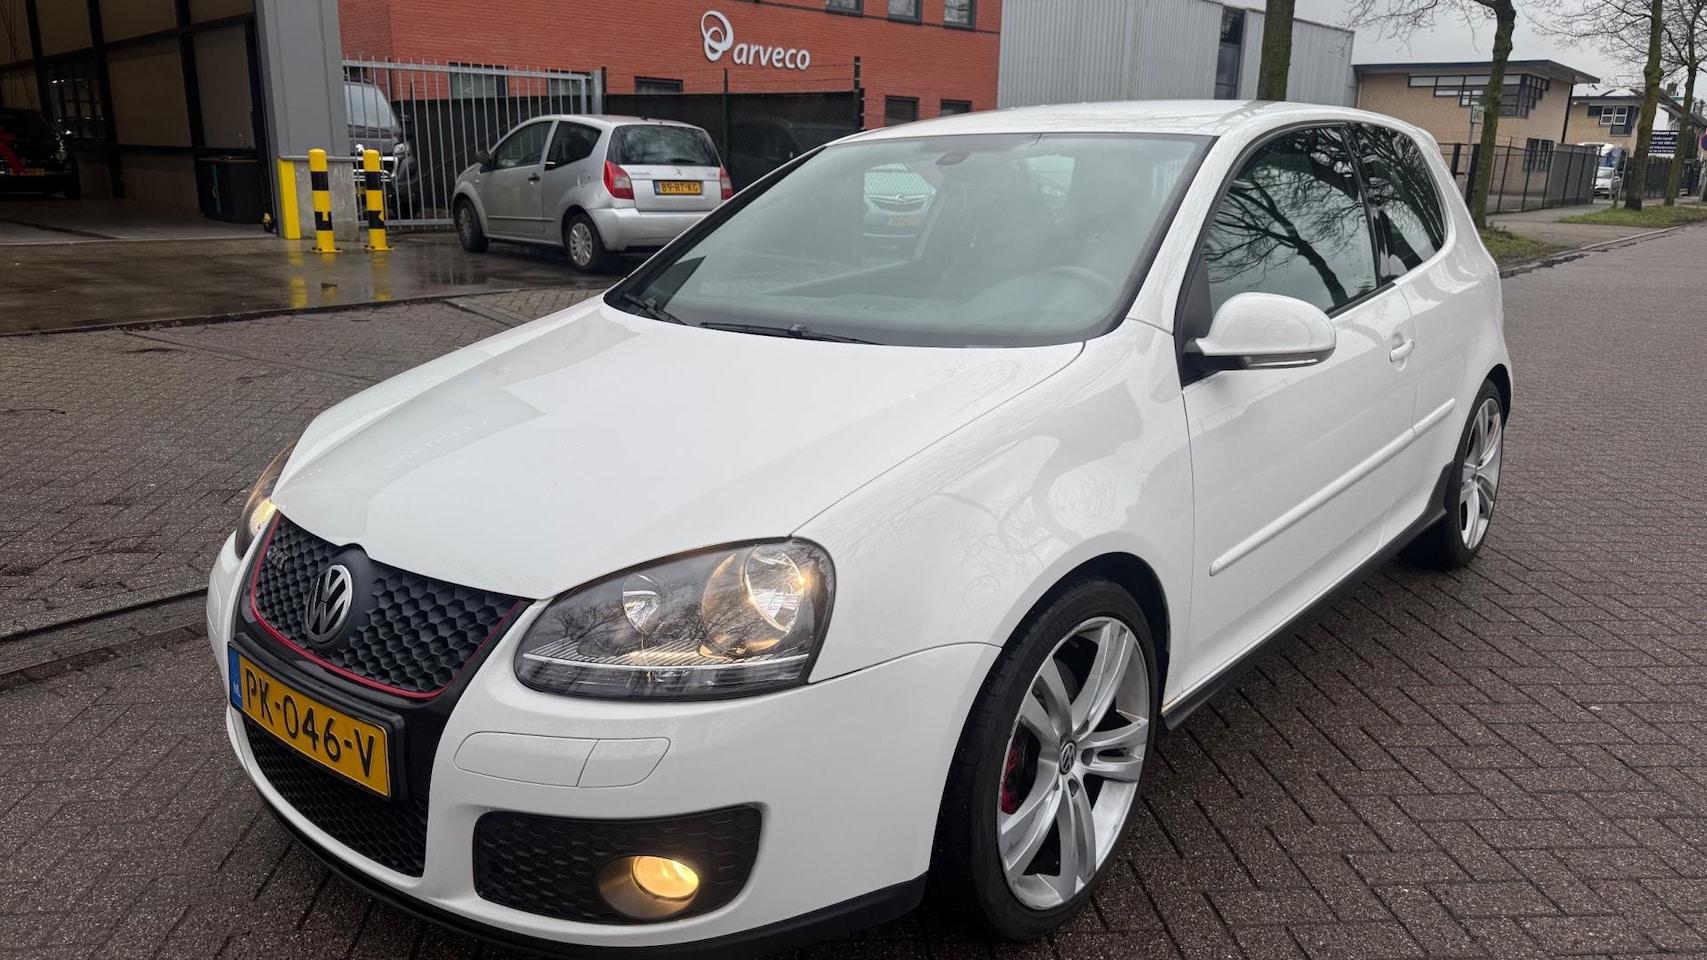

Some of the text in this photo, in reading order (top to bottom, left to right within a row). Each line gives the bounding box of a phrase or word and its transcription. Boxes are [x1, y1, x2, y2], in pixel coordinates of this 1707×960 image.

[733, 43, 811, 71] arveco
[661, 183, 698, 193] 89-RT-KG
[245, 666, 375, 779] PK-046-V
